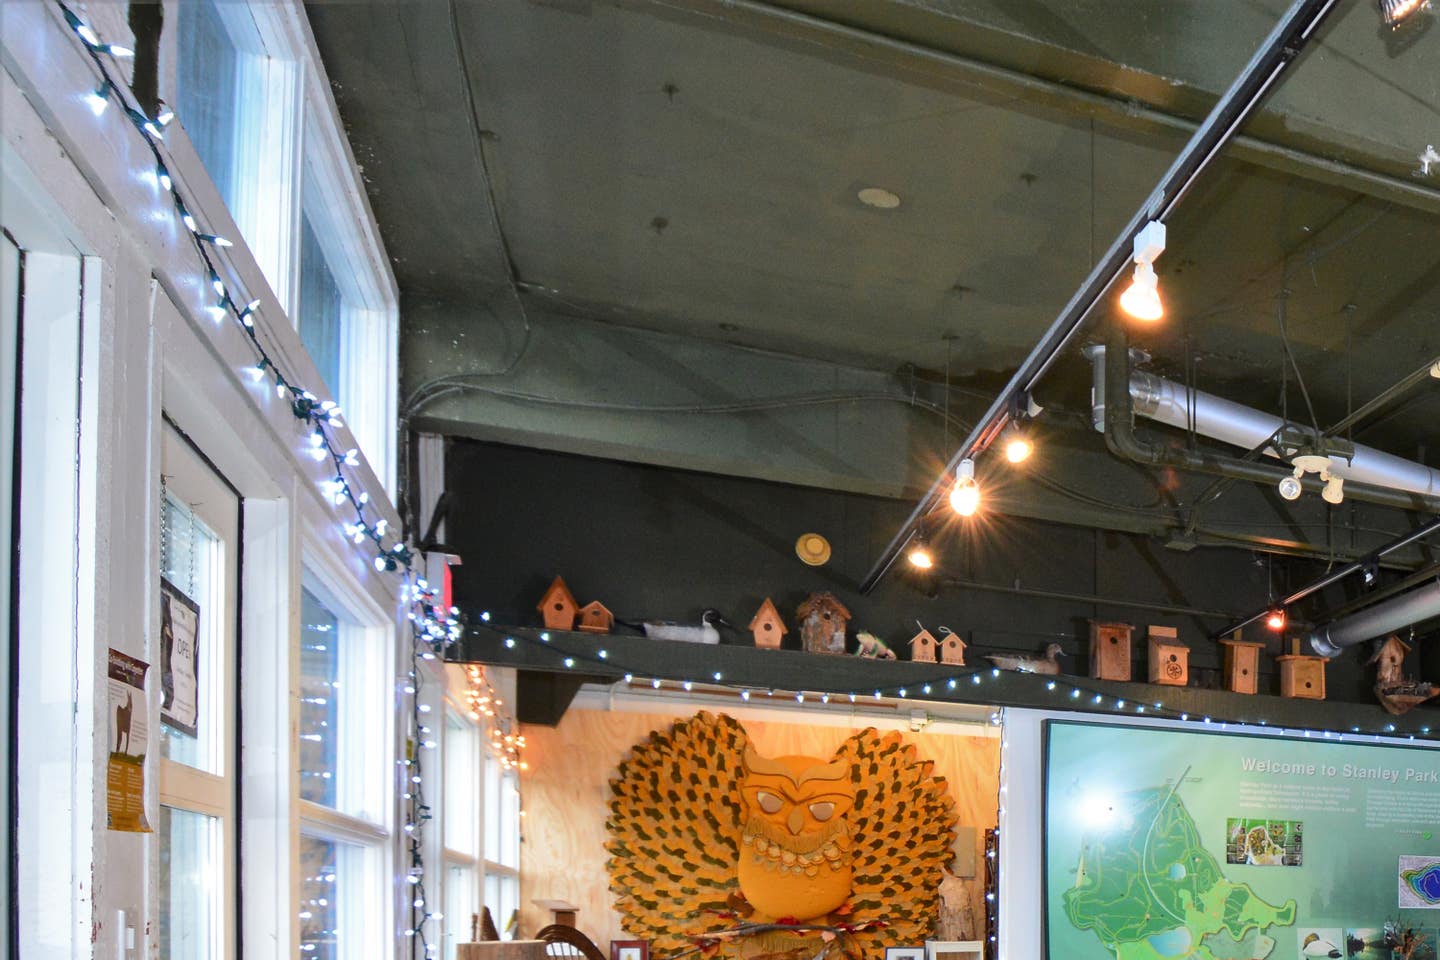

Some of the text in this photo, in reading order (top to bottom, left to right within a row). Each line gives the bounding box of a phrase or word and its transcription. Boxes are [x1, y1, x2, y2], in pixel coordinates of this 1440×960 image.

[1241, 757, 1440, 783] Welcome to Stanley Park
